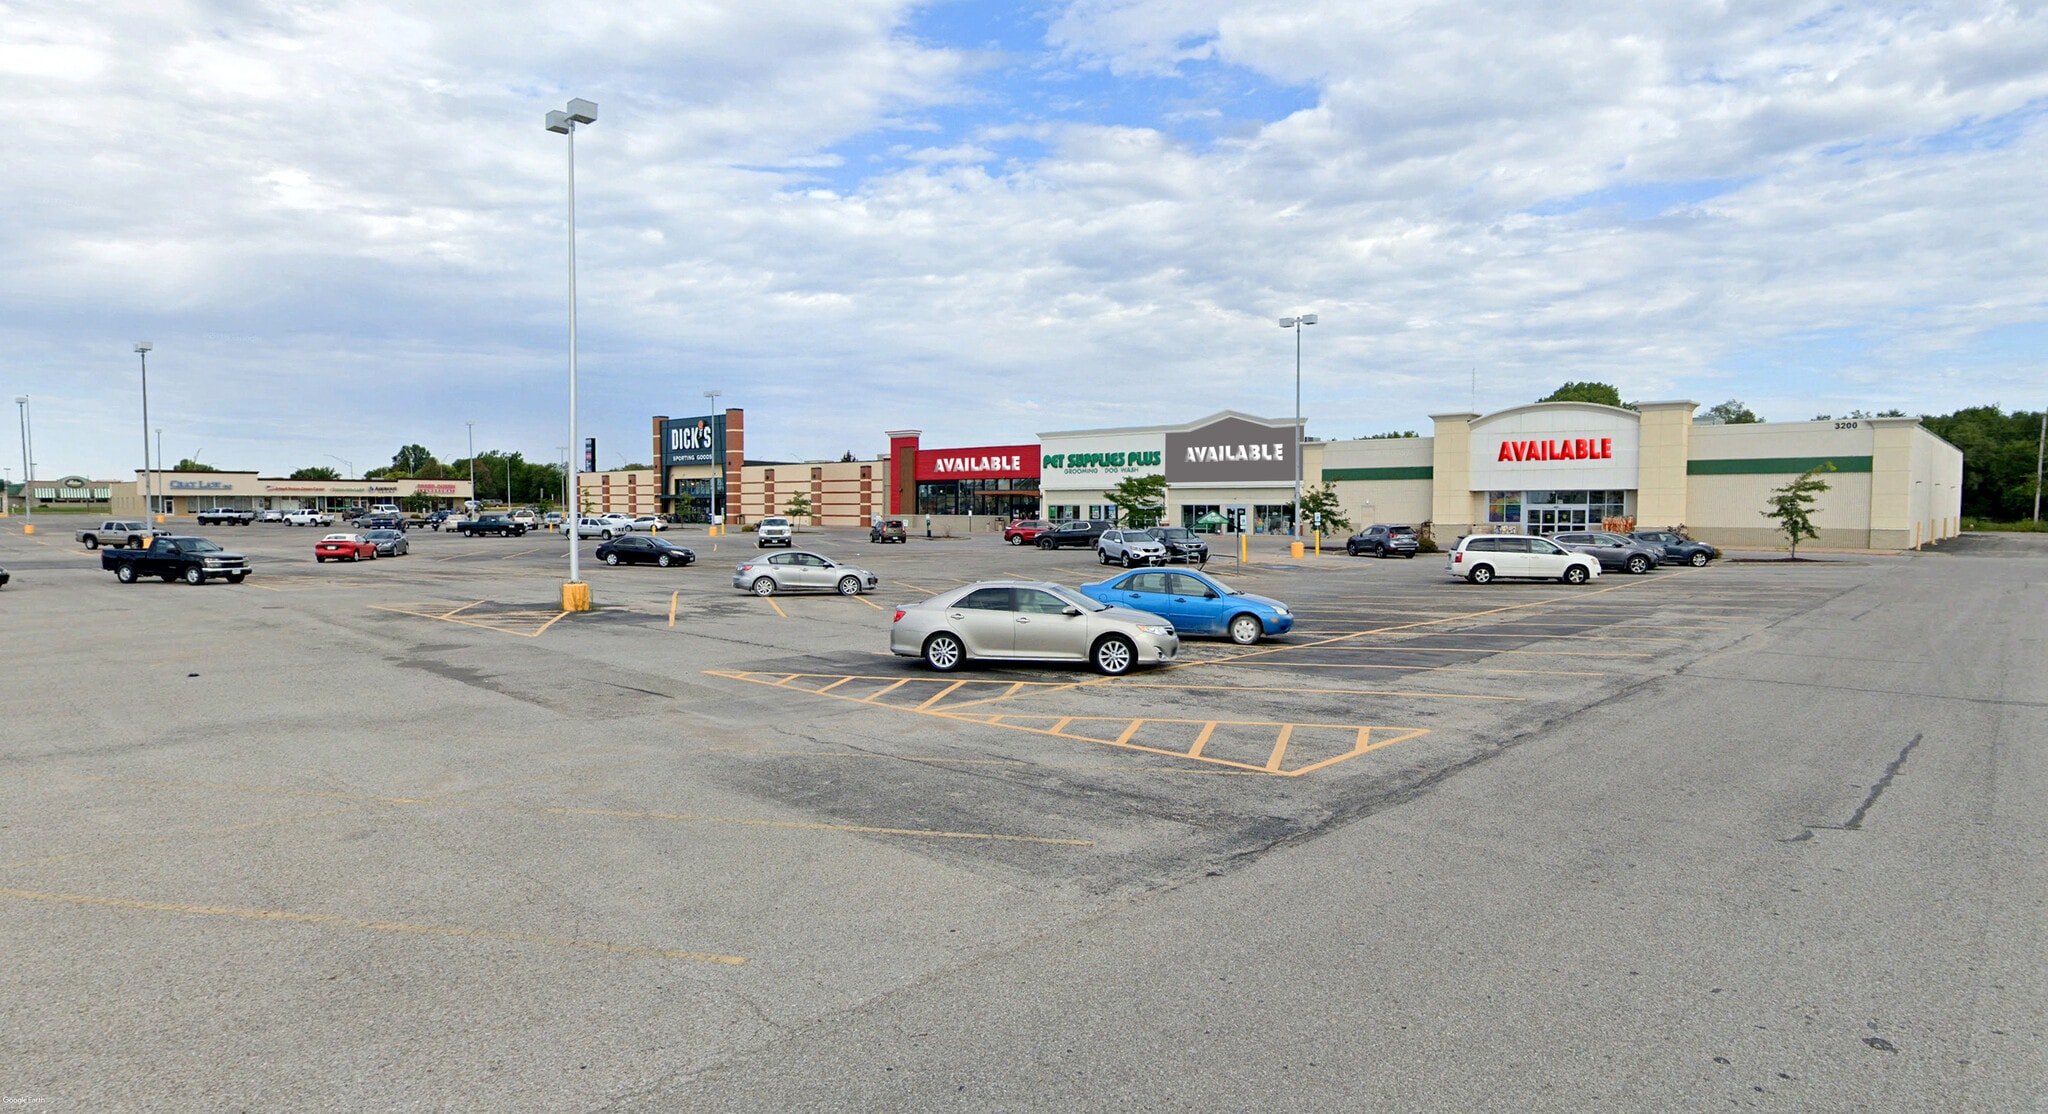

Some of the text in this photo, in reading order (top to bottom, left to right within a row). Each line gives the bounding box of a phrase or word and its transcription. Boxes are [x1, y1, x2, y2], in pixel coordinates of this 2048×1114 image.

[1834, 421, 1858, 430] 3200
[671, 425, 711, 450] DICK'S
[1184, 443, 1284, 463] AVAILABLE
[1497, 437, 1612, 462] AVAILABLE
[934, 455, 1021, 473] AVAILABLE
[1043, 451, 1161, 469] PET SUPPLIES PLUS
